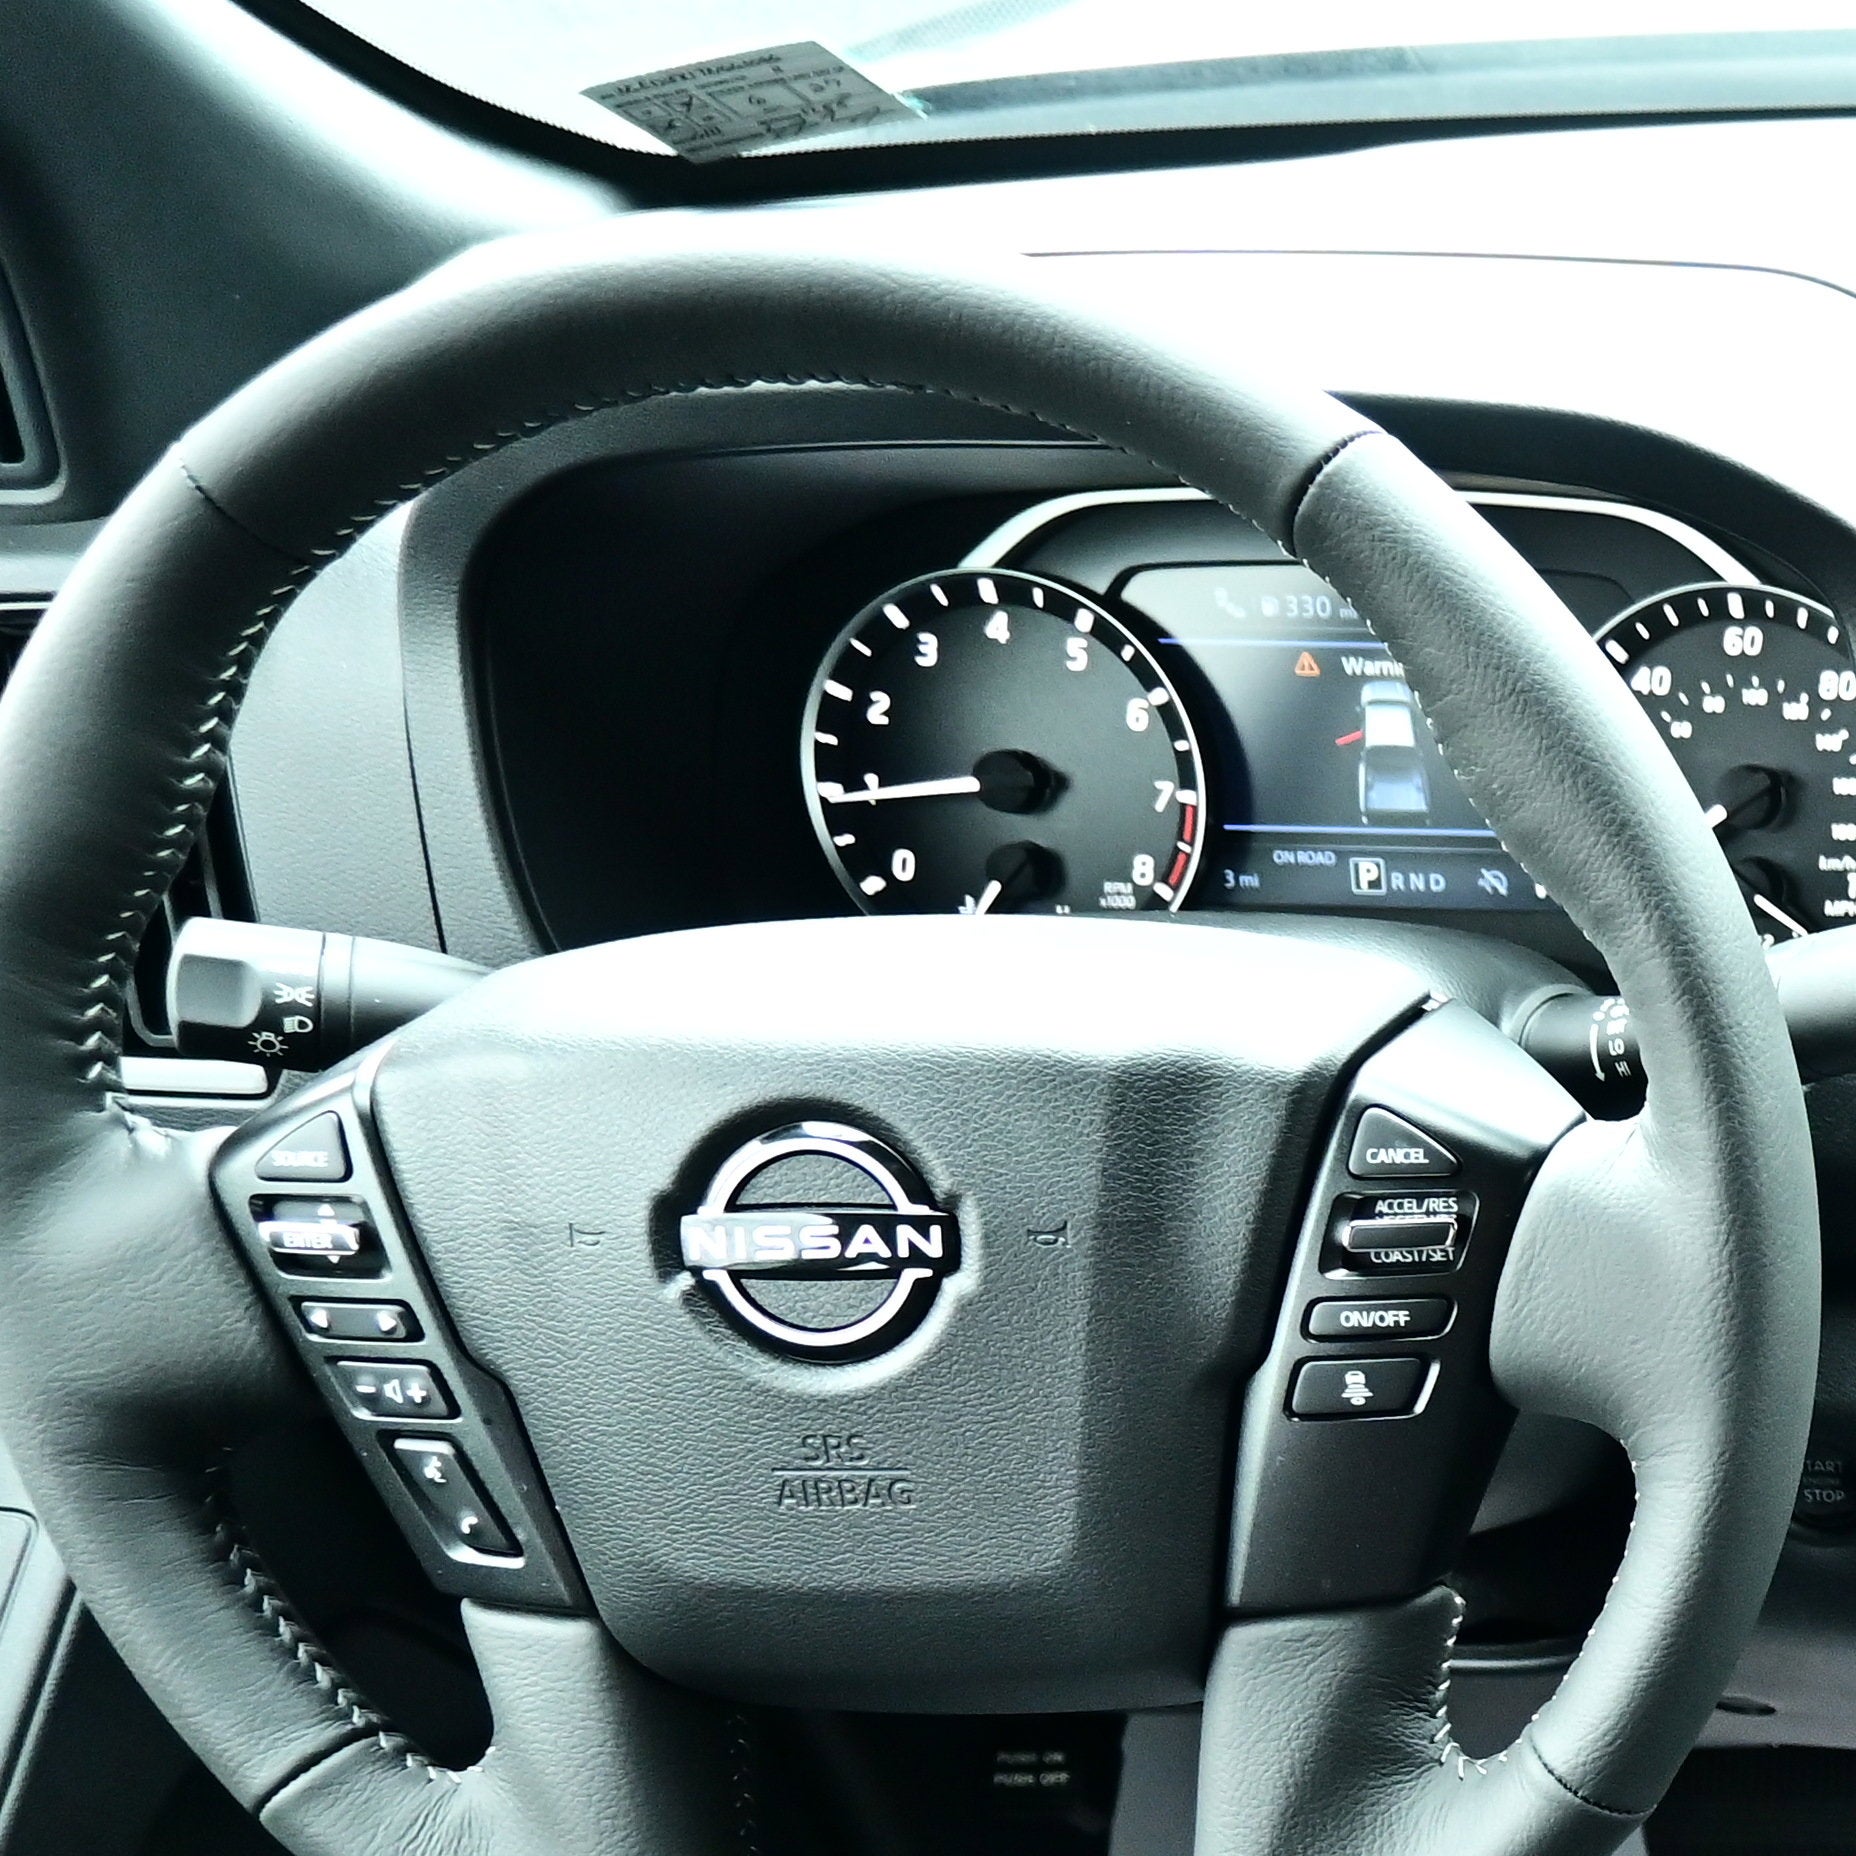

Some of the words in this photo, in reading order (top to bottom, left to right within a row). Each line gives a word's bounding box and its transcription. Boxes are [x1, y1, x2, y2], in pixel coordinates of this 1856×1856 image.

[1286, 595, 1332, 618] 330
[984, 611, 1010, 644] 4
[1722, 627, 1763, 656] 60
[914, 632, 938, 667] 3
[1065, 636, 1088, 671] 5
[1632, 667, 1672, 697] 40
[866, 690, 891, 725] 2
[1126, 697, 1149, 731] 6
[1153, 779, 1174, 812] 7
[892, 848, 915, 881] 0
[1132, 853, 1155, 887] 8
[1273, 849, 1295, 866] ON
[1297, 850, 1337, 867] ROAD
[1224, 868, 1235, 890] 3
[1238, 871, 1260, 889] mi
[1357, 860, 1379, 891] P
[1391, 871, 1406, 891] R
[1409, 872, 1425, 891] N
[1429, 872, 1447, 893] D
[1608, 1037, 1625, 1056] LO
[1614, 1060, 1632, 1078] HI
[1366, 1148, 1430, 1164] CANCEL
[1373, 1197, 1459, 1214] ACCEL/RES
[687, 1224, 945, 1261] NISSAN
[1339, 1309, 1412, 1328] ON/OFF
[800, 1433, 870, 1466] SRS
[776, 1477, 917, 1510] AIRBAG
[1802, 1488, 1846, 1504] STOP
